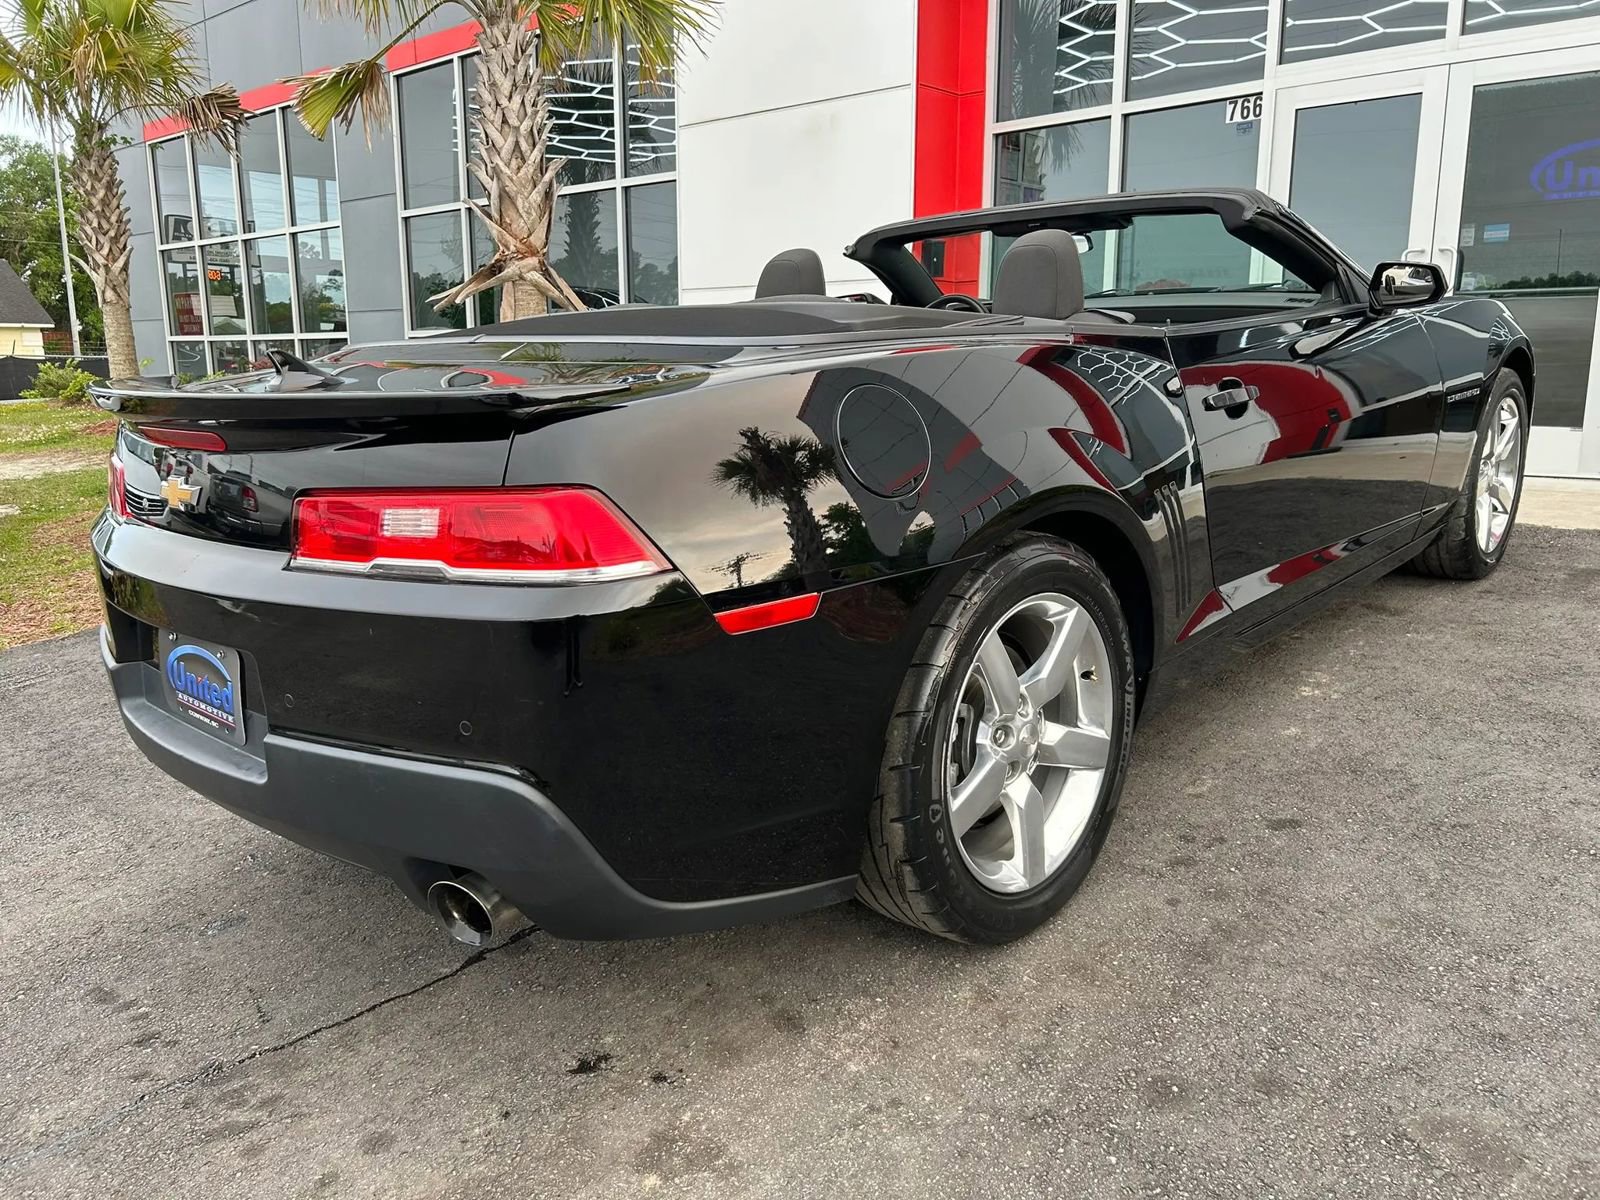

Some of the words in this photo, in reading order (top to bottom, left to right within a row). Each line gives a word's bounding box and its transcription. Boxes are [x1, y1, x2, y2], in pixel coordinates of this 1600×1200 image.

[1229, 96, 1263, 121] 766
[172, 659, 234, 714] United
[176, 690, 234, 723] AUTOMOTIVE
